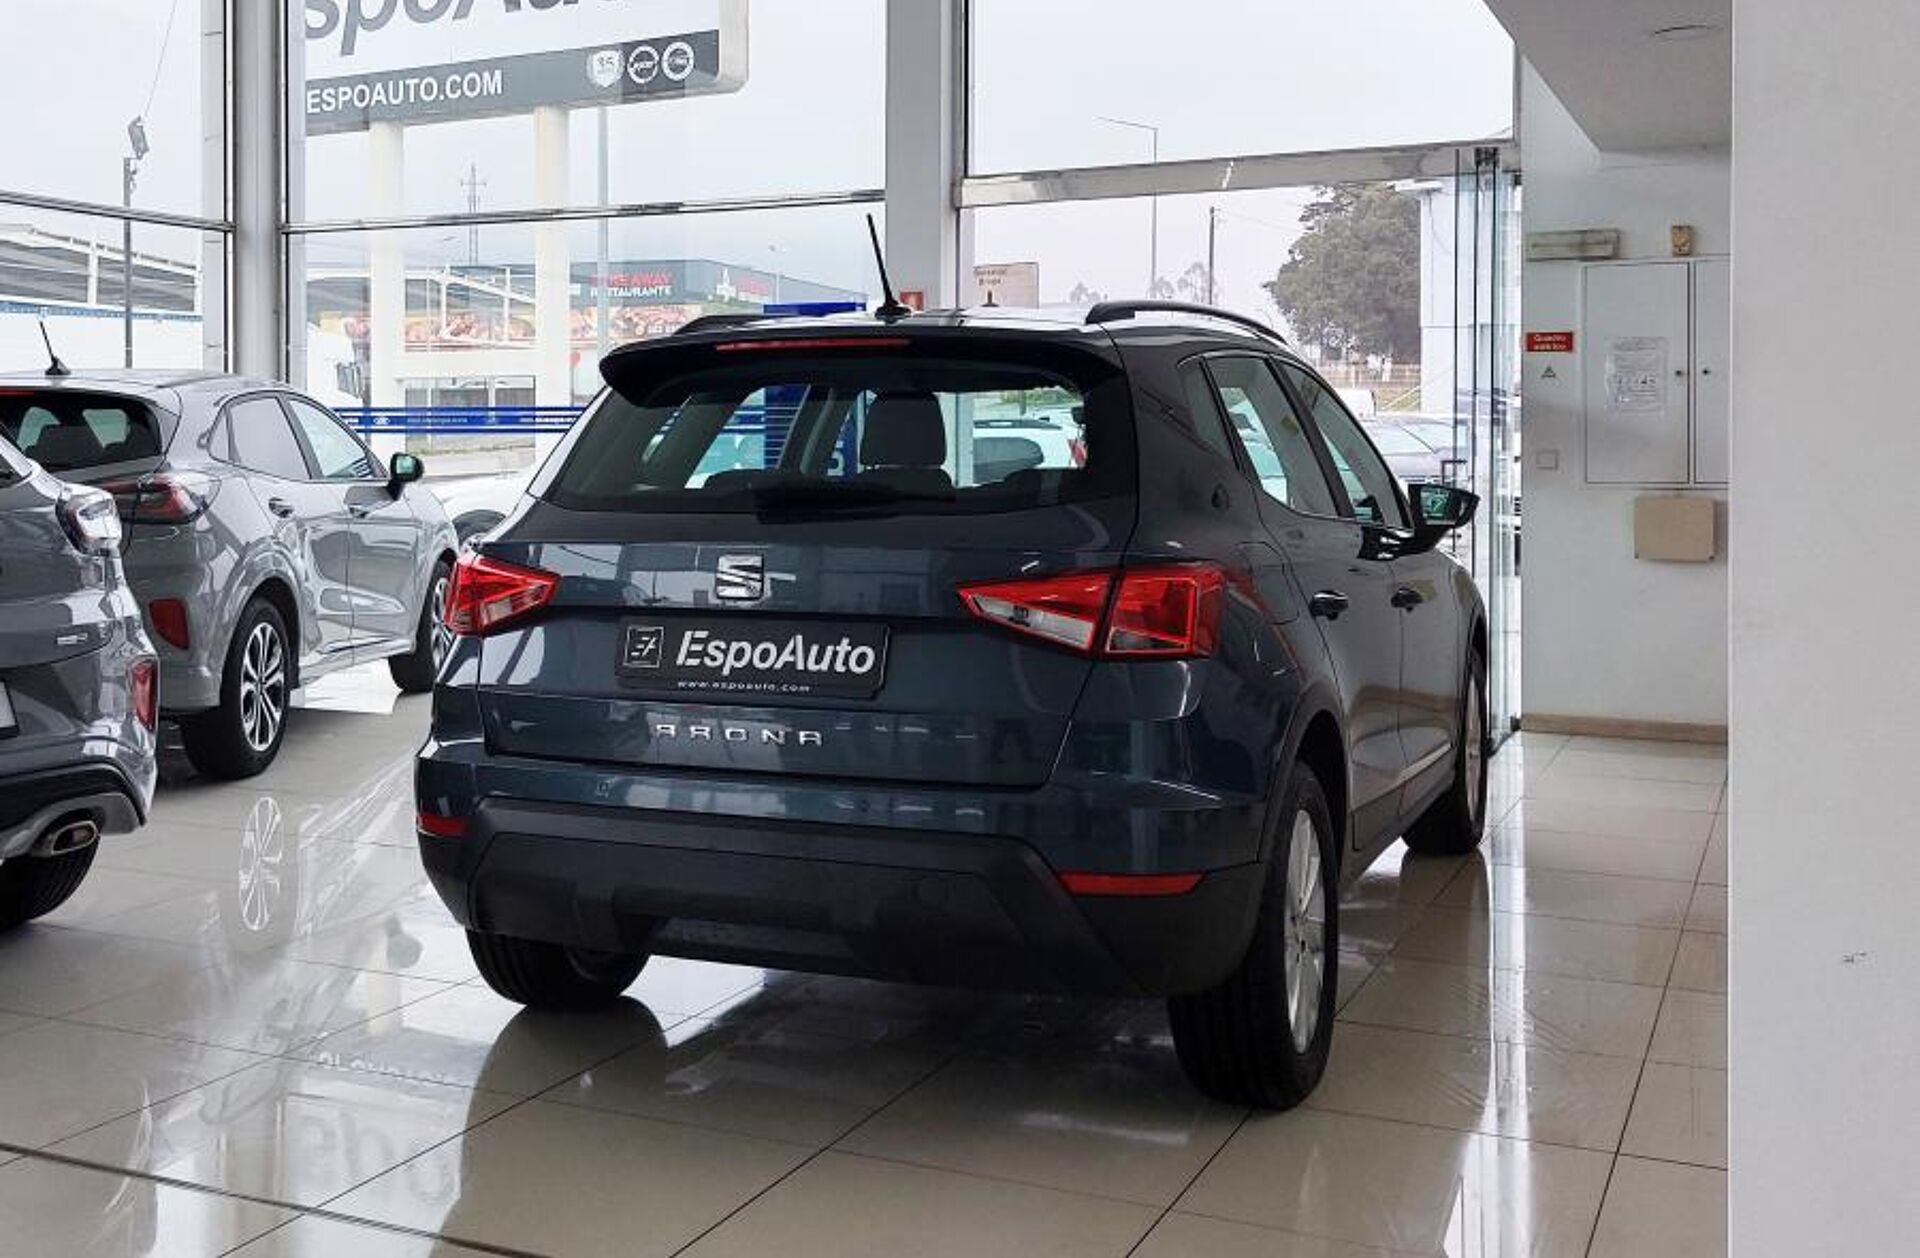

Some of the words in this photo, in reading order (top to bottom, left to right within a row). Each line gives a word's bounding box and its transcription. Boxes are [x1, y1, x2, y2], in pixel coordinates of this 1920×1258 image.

[306, 69, 503, 114] ESPOAUTO.COM
[676, 630, 875, 677] EspoAuto
[677, 680, 810, 693] www.espoauto.com
[655, 723, 823, 747] ARONA
